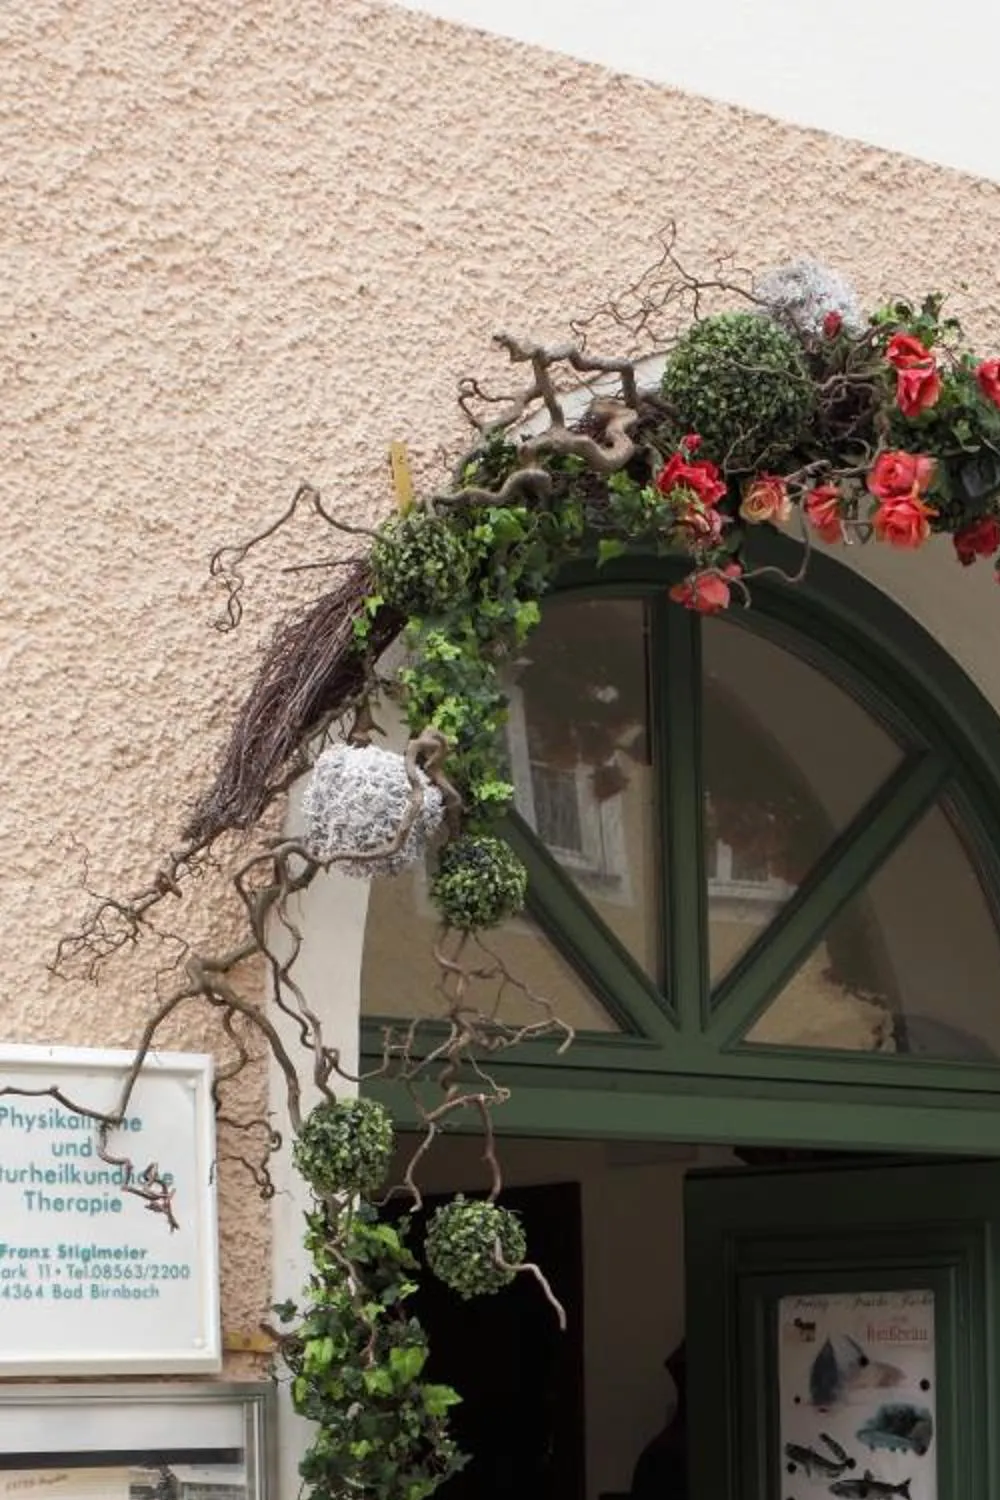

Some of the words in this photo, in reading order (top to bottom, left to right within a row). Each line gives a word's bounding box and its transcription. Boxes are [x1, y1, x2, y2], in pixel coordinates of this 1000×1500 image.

[51, 1136, 93, 1158] und
[23, 1189, 123, 1217] Therapie
[0, 1243, 51, 1259] Franz
[57, 1243, 148, 1263] Stiglmeier
[52, 1283, 83, 1300] Bad
[91, 1283, 160, 1300] Birnbach
